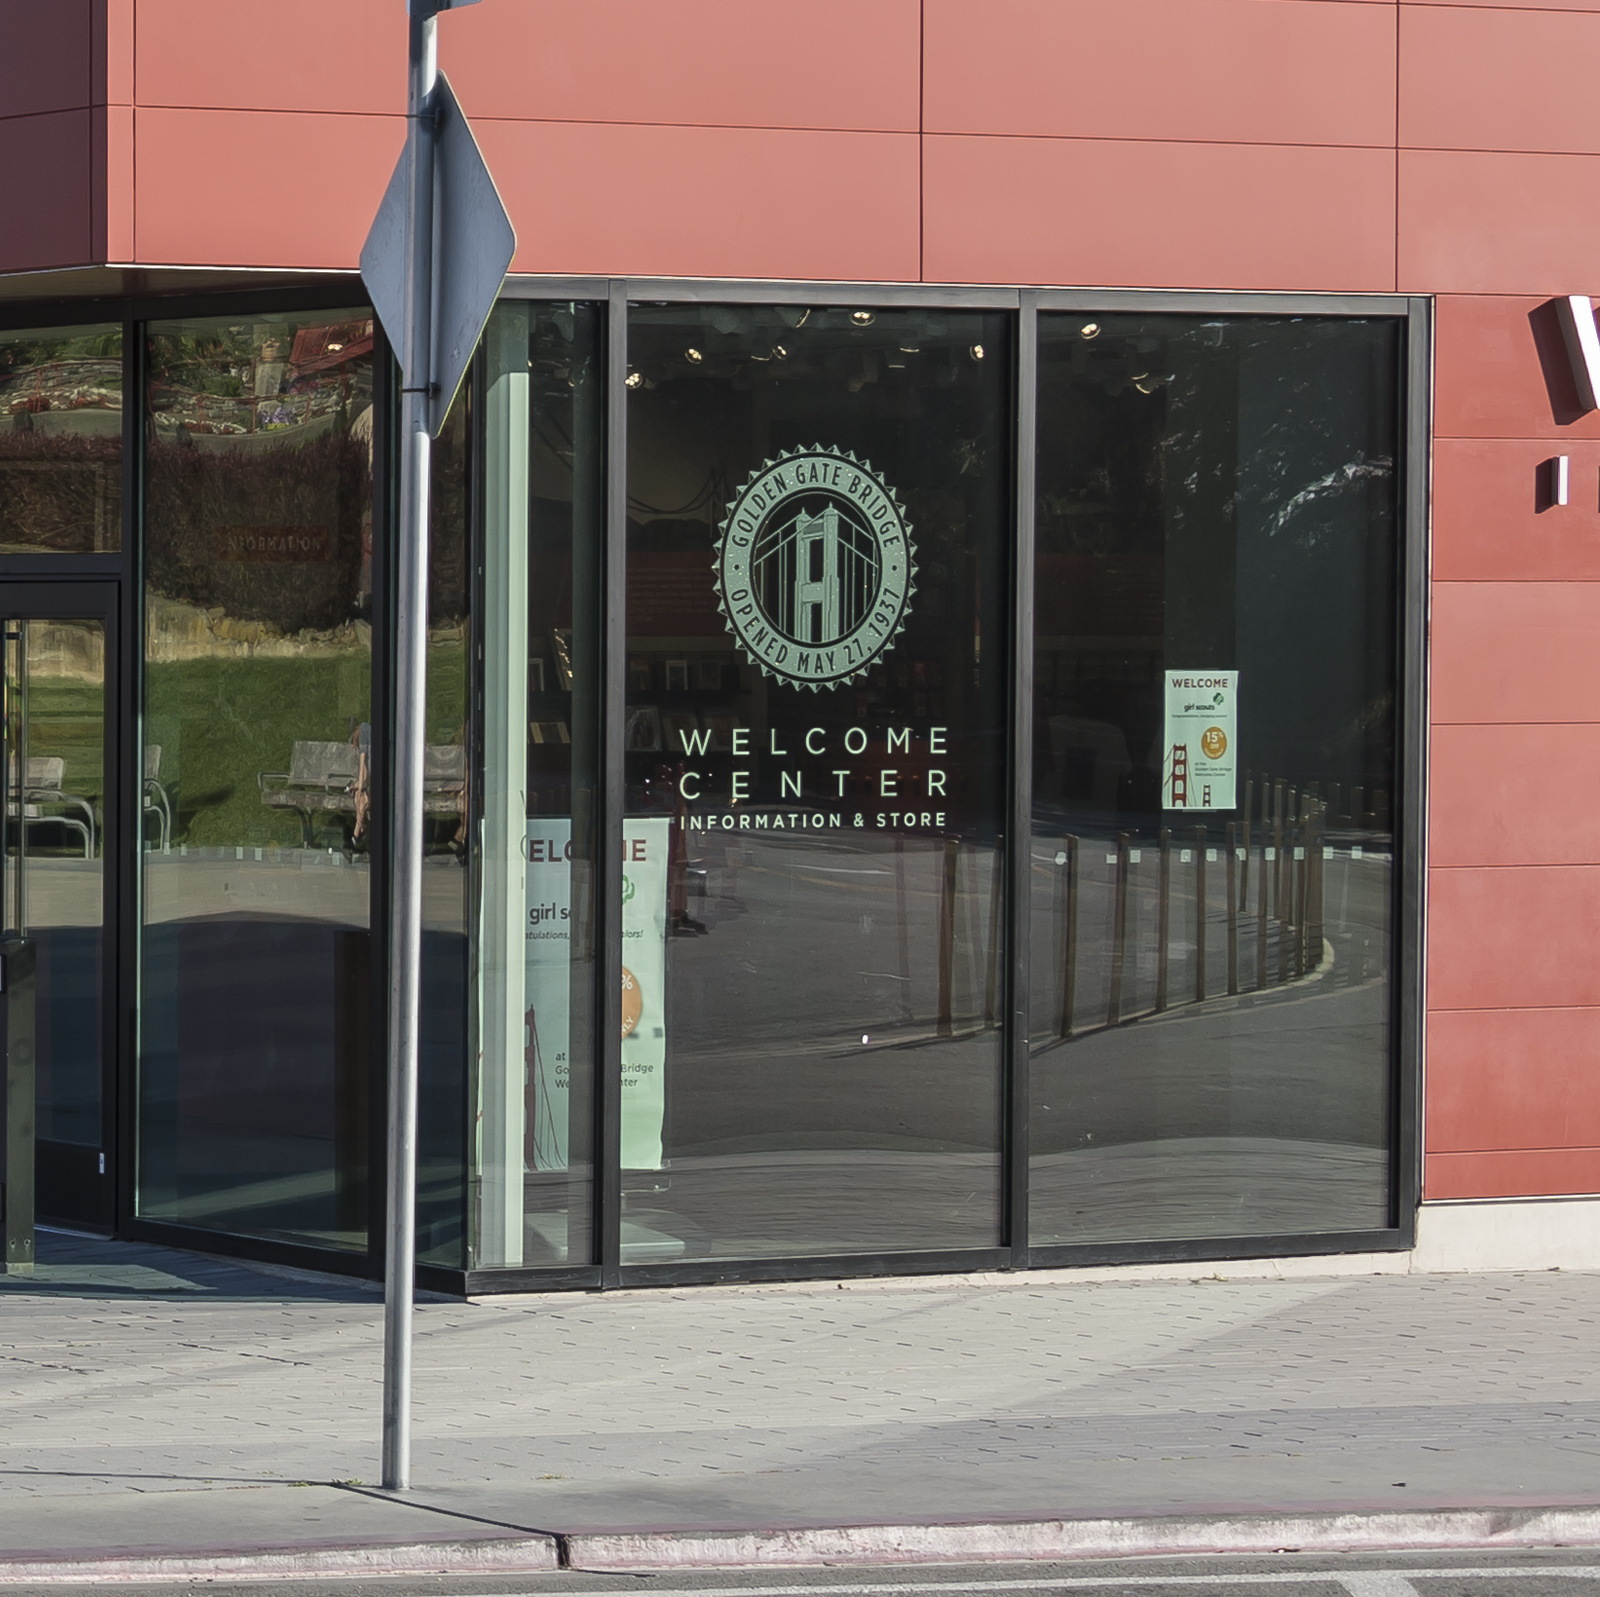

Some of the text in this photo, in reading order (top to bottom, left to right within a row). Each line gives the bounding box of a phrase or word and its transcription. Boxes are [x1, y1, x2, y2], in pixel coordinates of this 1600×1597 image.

[732, 462, 901, 549] GOLDEN GATE BRIDGE
[226, 535, 321, 552] NFORMATION
[730, 587, 789, 665] OPENED
[797, 651, 836, 675] MAY
[843, 639, 872, 666] 27,
[868, 588, 902, 637] 1937
[1171, 678, 1229, 688] WELCOME
[1183, 703, 1195, 712] girl
[678, 727, 949, 757] WELCOME
[678, 769, 948, 799] CENTER
[680, 812, 947, 830] INFORMATION & STORE
[529, 902, 556, 925] girl
[526, 930, 570, 940] tulations,
[555, 1052, 566, 1061] at
